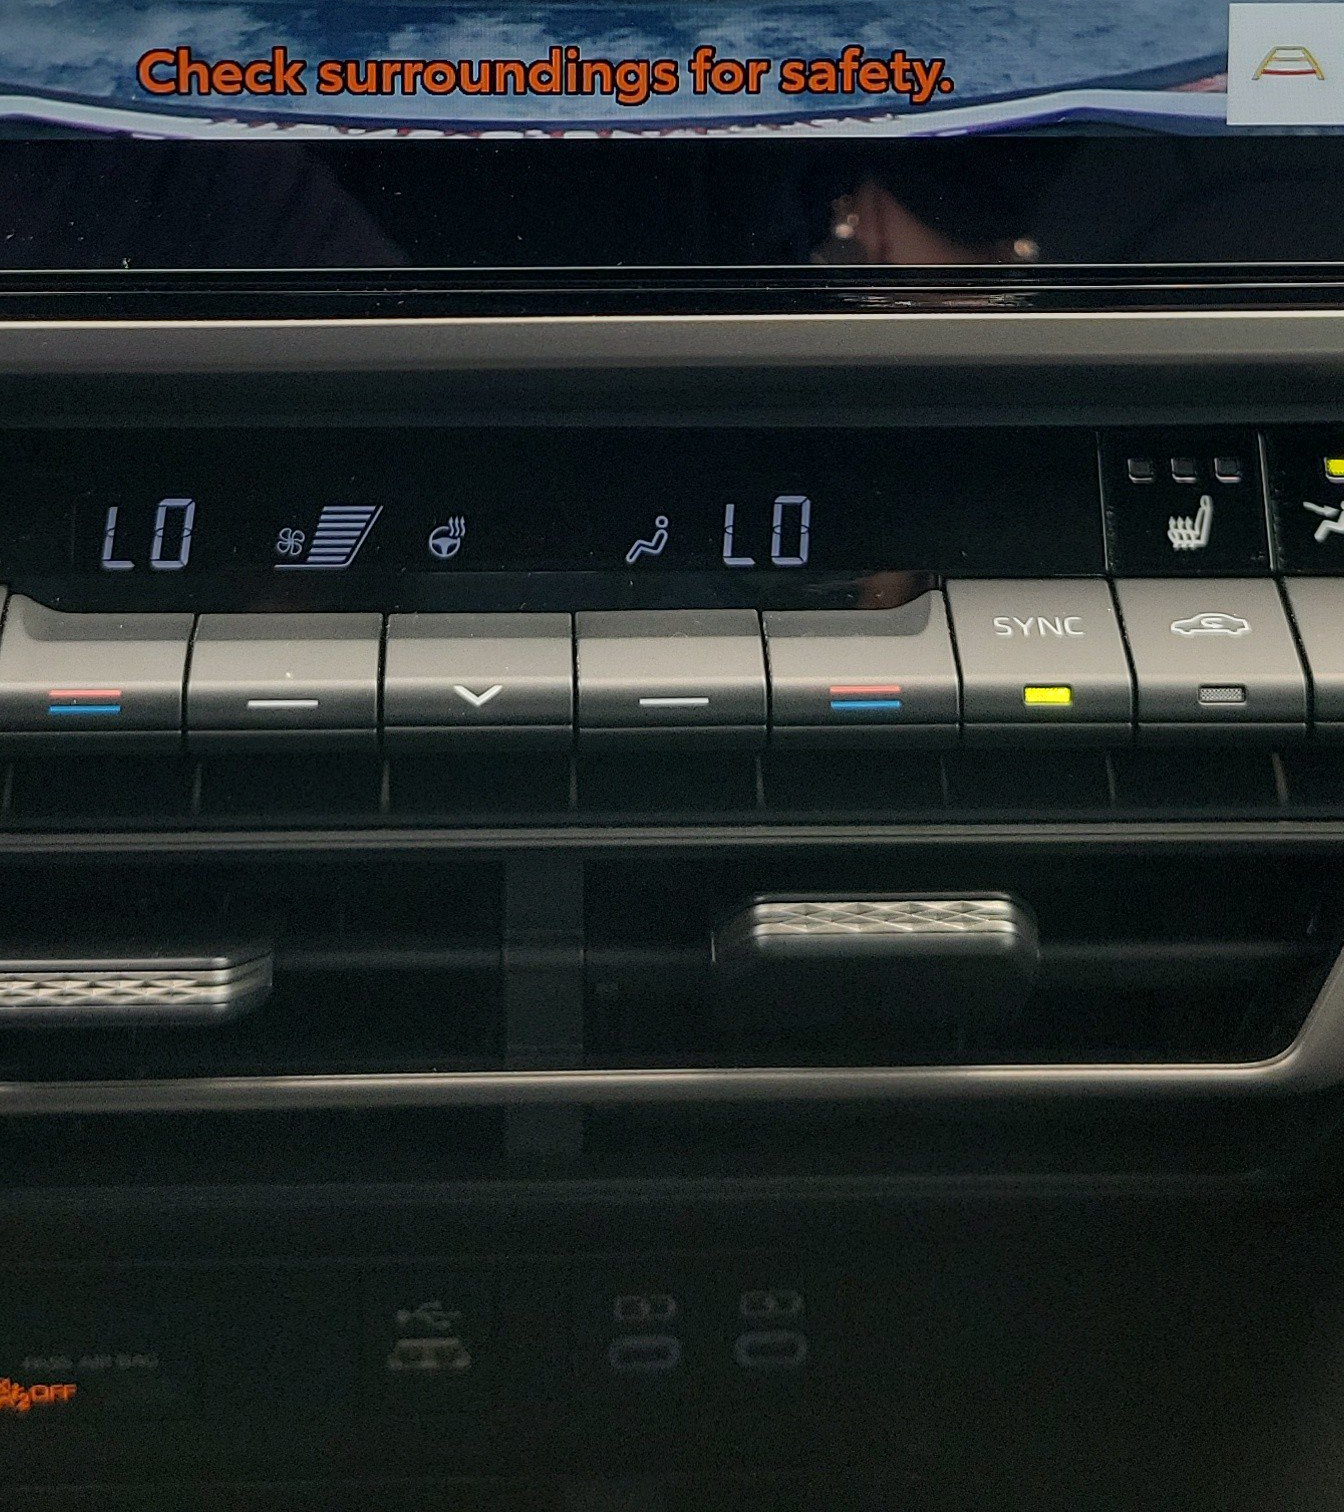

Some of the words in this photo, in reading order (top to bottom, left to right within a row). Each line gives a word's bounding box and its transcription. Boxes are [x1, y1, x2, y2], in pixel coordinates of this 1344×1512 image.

[138, 47, 305, 95] Check
[317, 47, 677, 104] surroundings
[689, 46, 770, 94] for
[778, 46, 955, 104] safety.
[100, 497, 196, 570] LO
[722, 495, 812, 566] LO
[993, 616, 1086, 637] SYNC
[29, 1383, 79, 1403] OFF
